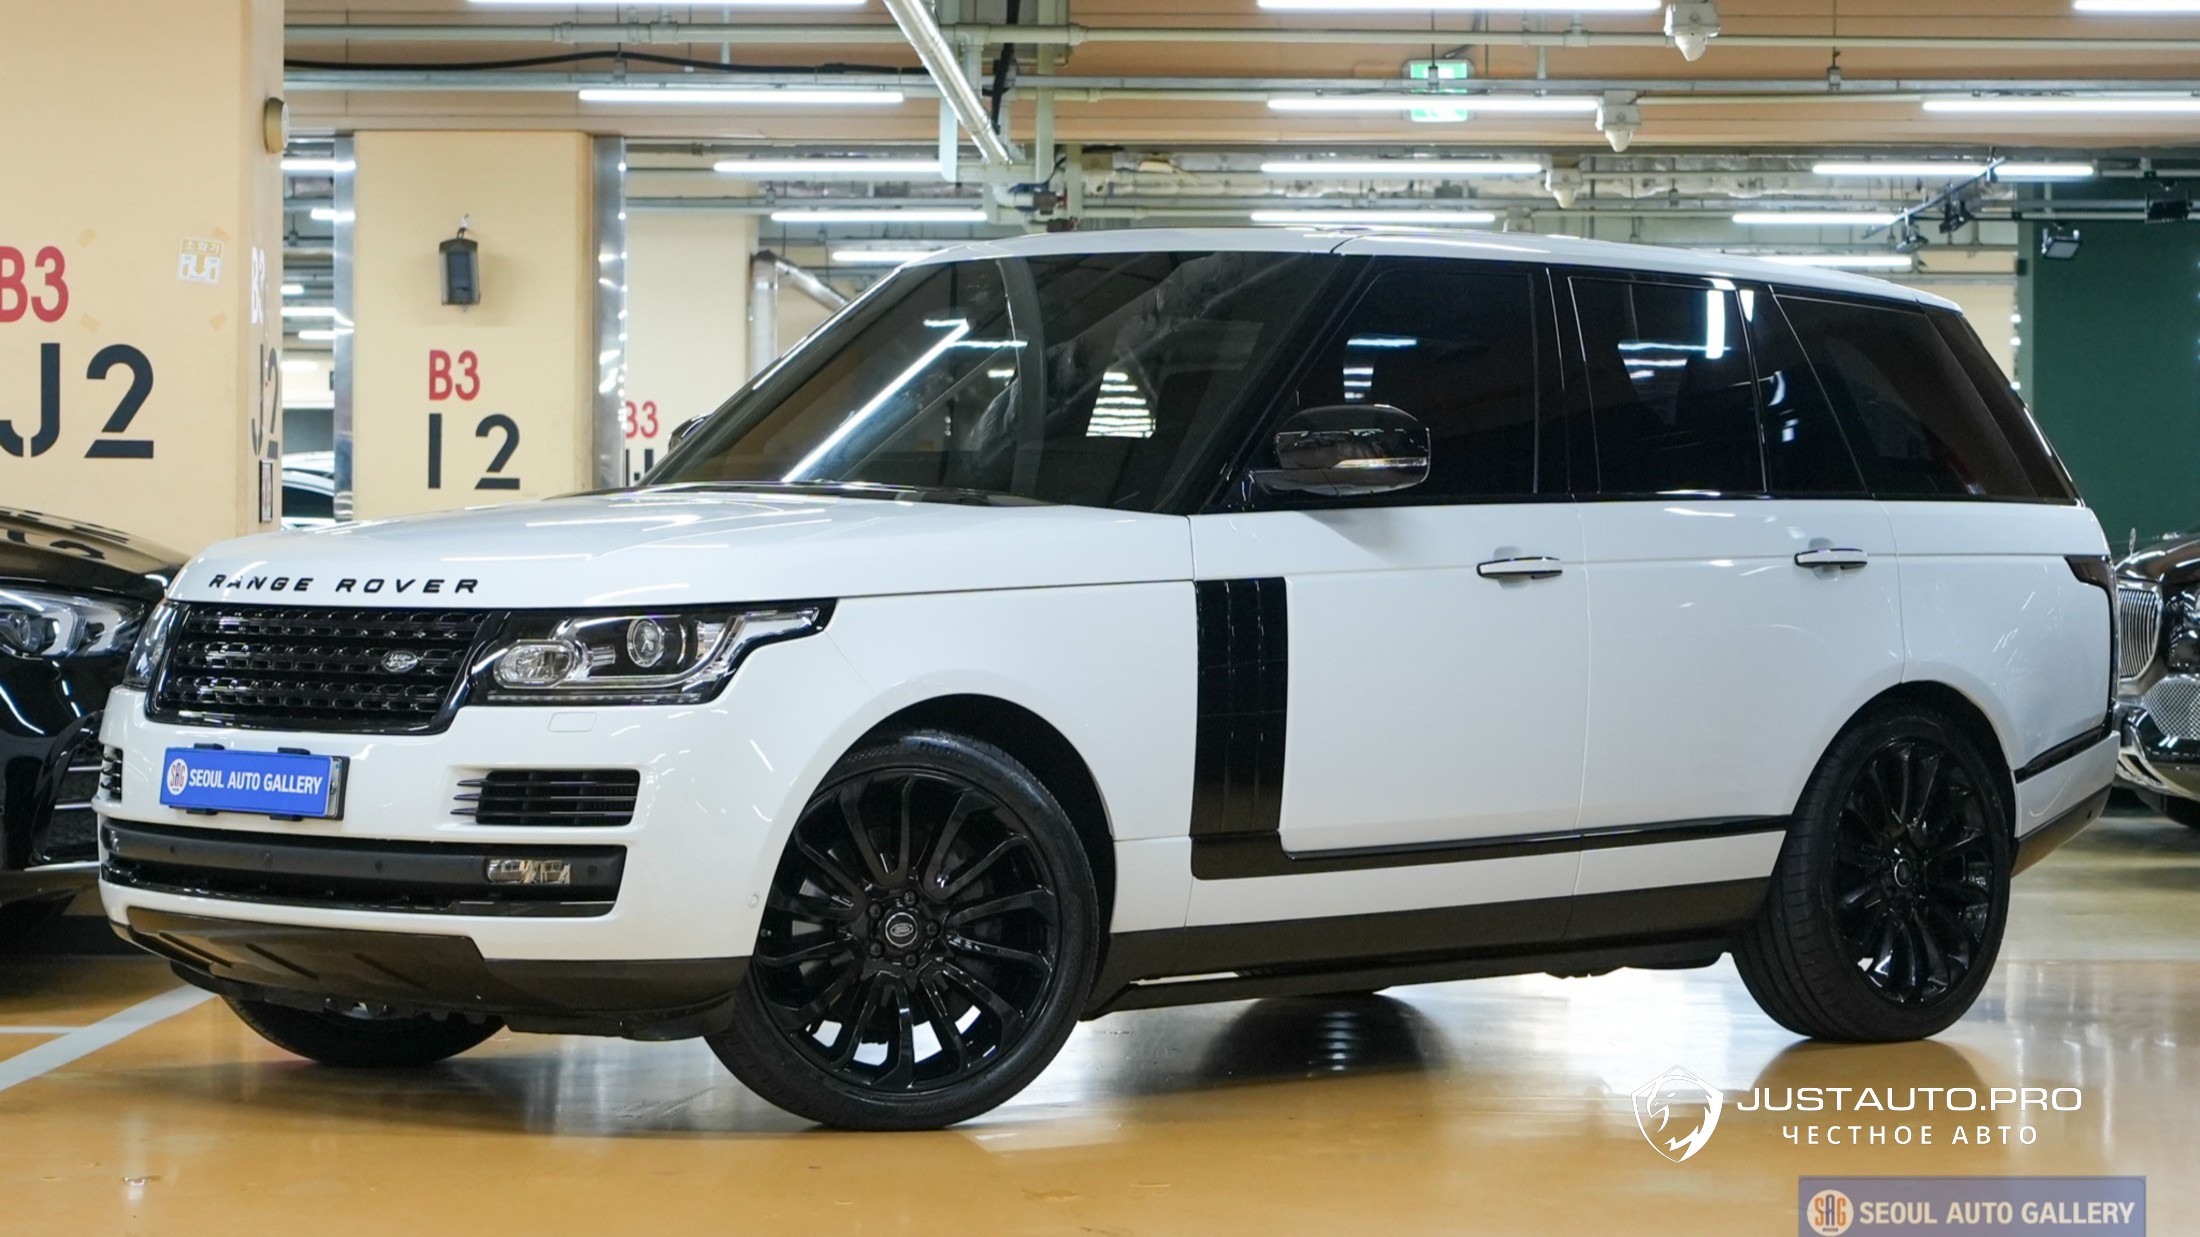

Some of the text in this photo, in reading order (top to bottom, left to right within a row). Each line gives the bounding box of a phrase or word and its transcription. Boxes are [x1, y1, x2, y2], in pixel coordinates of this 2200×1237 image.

[0, 246, 69, 323] B3
[429, 349, 481, 401] B3
[208, 573, 479, 594] RANGE ROVER
[188, 768, 323, 796] SEOUL AUTO GALLERY
